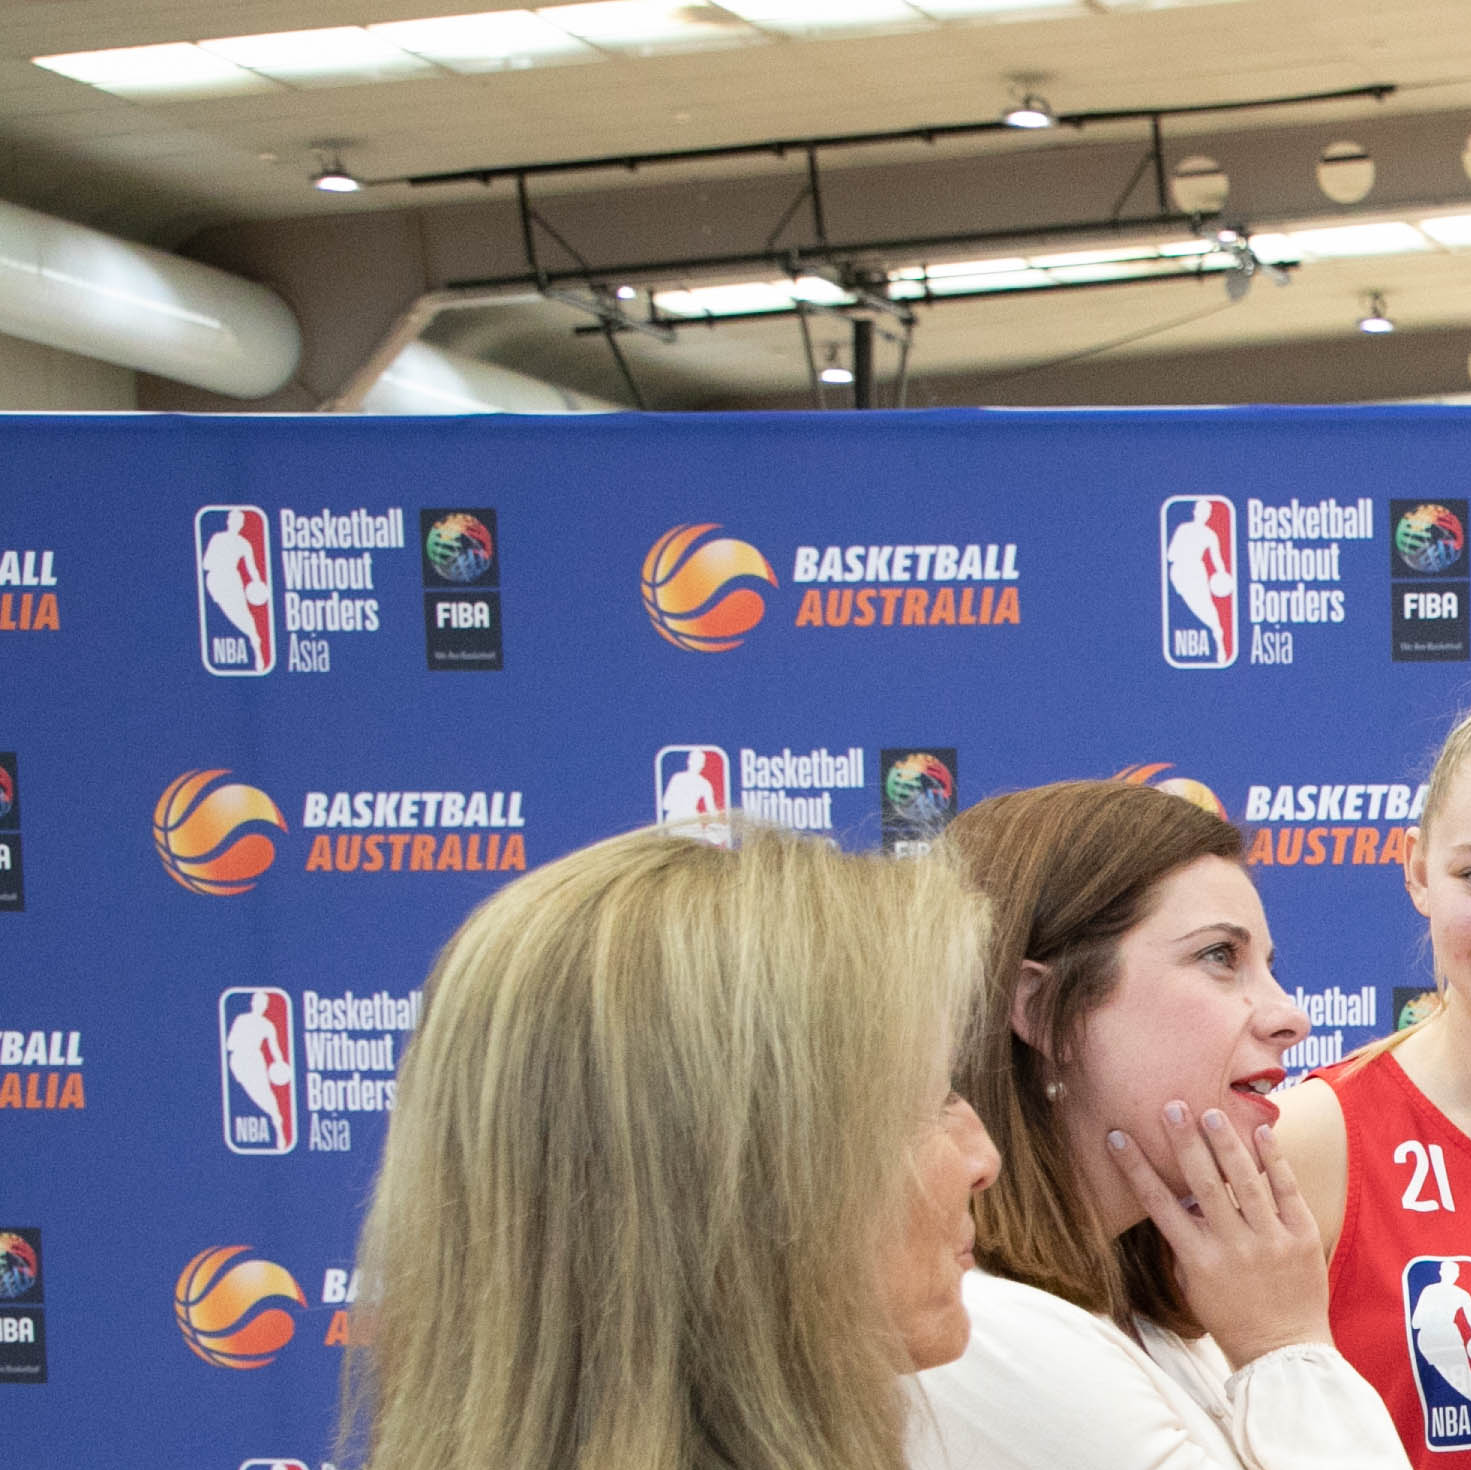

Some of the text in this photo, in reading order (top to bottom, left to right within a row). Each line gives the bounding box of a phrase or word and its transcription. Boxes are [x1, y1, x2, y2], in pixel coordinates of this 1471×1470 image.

[280, 508, 403, 548] Basketball
[1248, 498, 1372, 539] Basketball
[282, 550, 373, 589] Without
[794, 544, 1019, 581] BASKETBALL
[1248, 541, 1340, 581] Without
[285, 591, 378, 631] Borders
[437, 602, 489, 628] FIBA
[796, 587, 1019, 627] AUSTRALIA
[1250, 583, 1344, 622] Borders
[1404, 592, 1457, 619] FIBA
[213, 638, 247, 663] NBA
[288, 633, 329, 672] Asia
[1175, 630, 1209, 656] NBA
[1251, 624, 1292, 664] Asia
[741, 748, 863, 788] Basketball
[303, 792, 524, 827] BASKETBALL
[1246, 785, 1429, 821] BASKETBA
[306, 835, 525, 871] AUSTRALIA
[1248, 827, 1405, 865] AUSTRA
[0, 1031, 82, 1065] BALL
[304, 1032, 394, 1070] Without
[307, 1074, 398, 1112] Borders
[235, 1117, 269, 1142] NBA
[309, 1112, 350, 1151] Asia
[1394, 1141, 1456, 1212] 21
[1432, 1406, 1471, 1438] NBA
